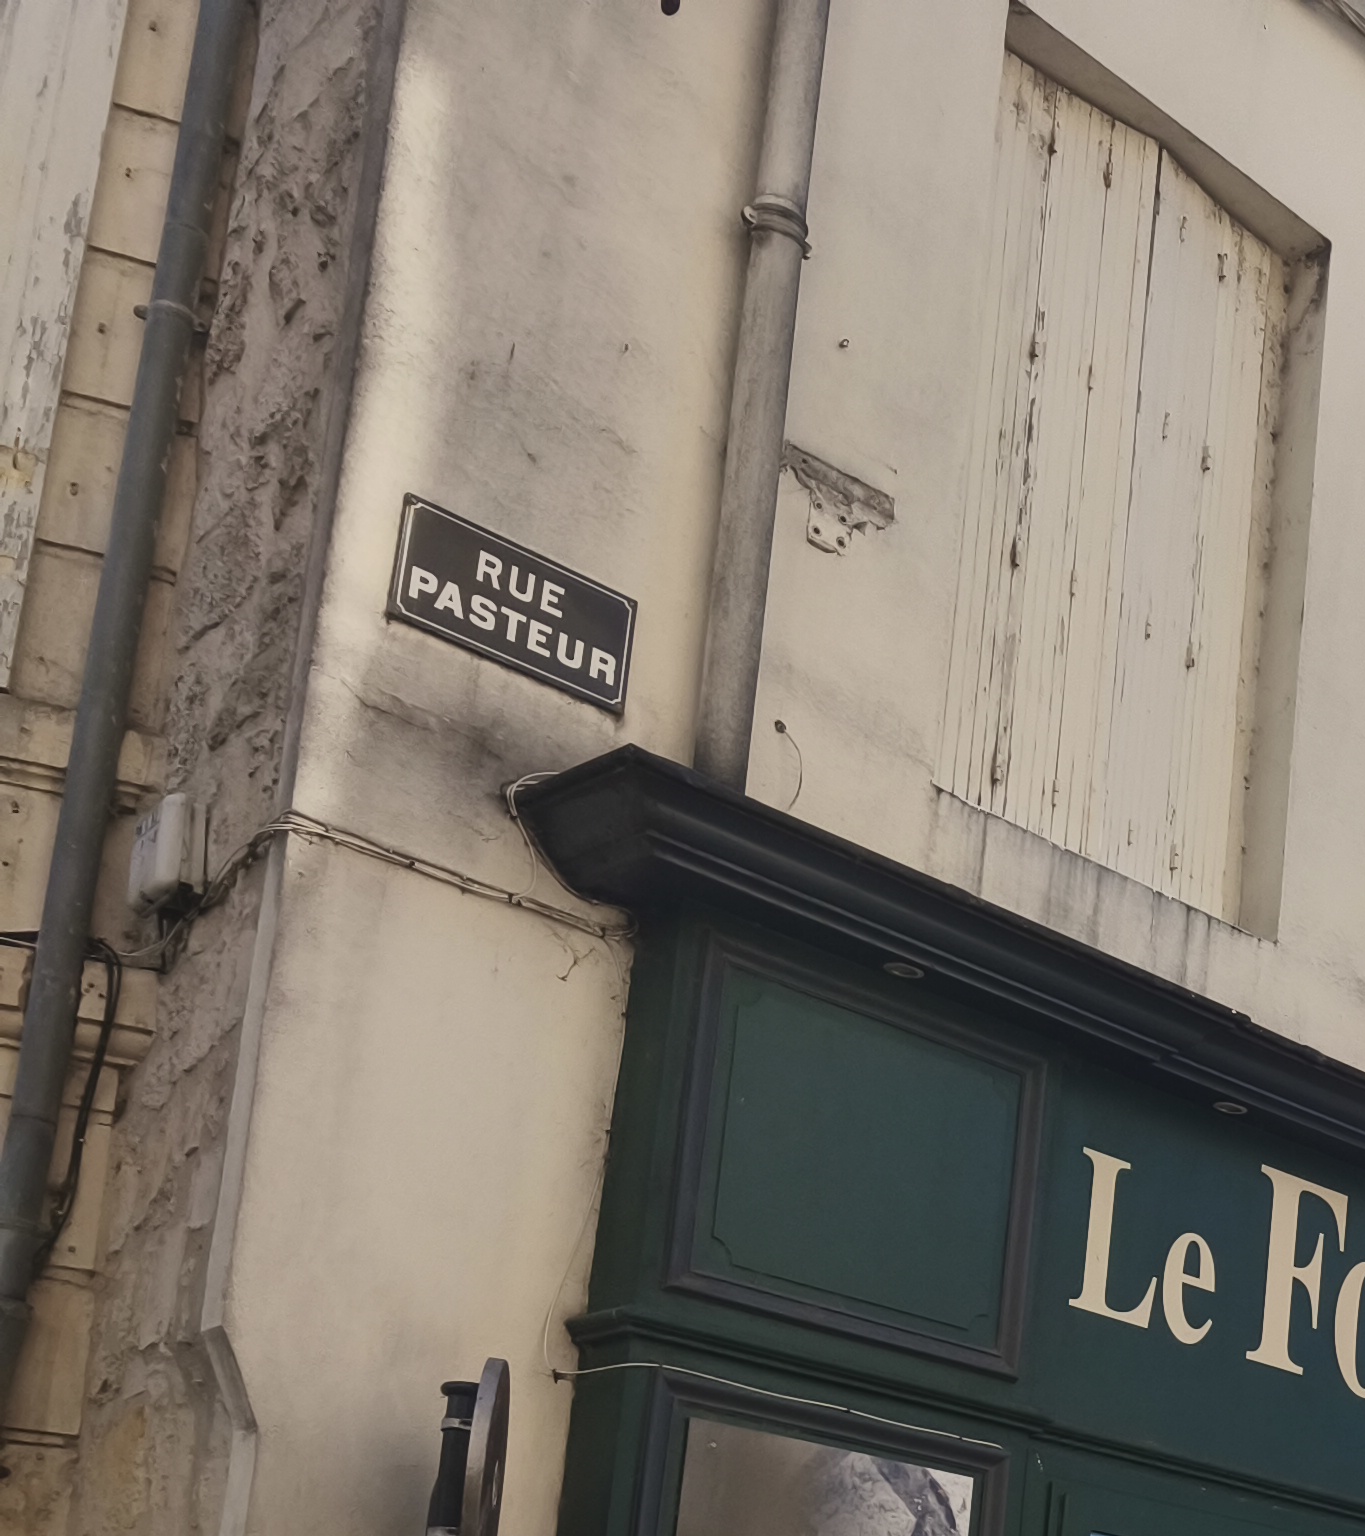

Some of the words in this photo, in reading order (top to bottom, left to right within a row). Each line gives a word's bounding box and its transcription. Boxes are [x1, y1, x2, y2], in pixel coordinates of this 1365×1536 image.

[408, 565, 617, 687] PASTEUR
[475, 550, 566, 619] RUE
[1068, 1146, 1217, 1346] Le
